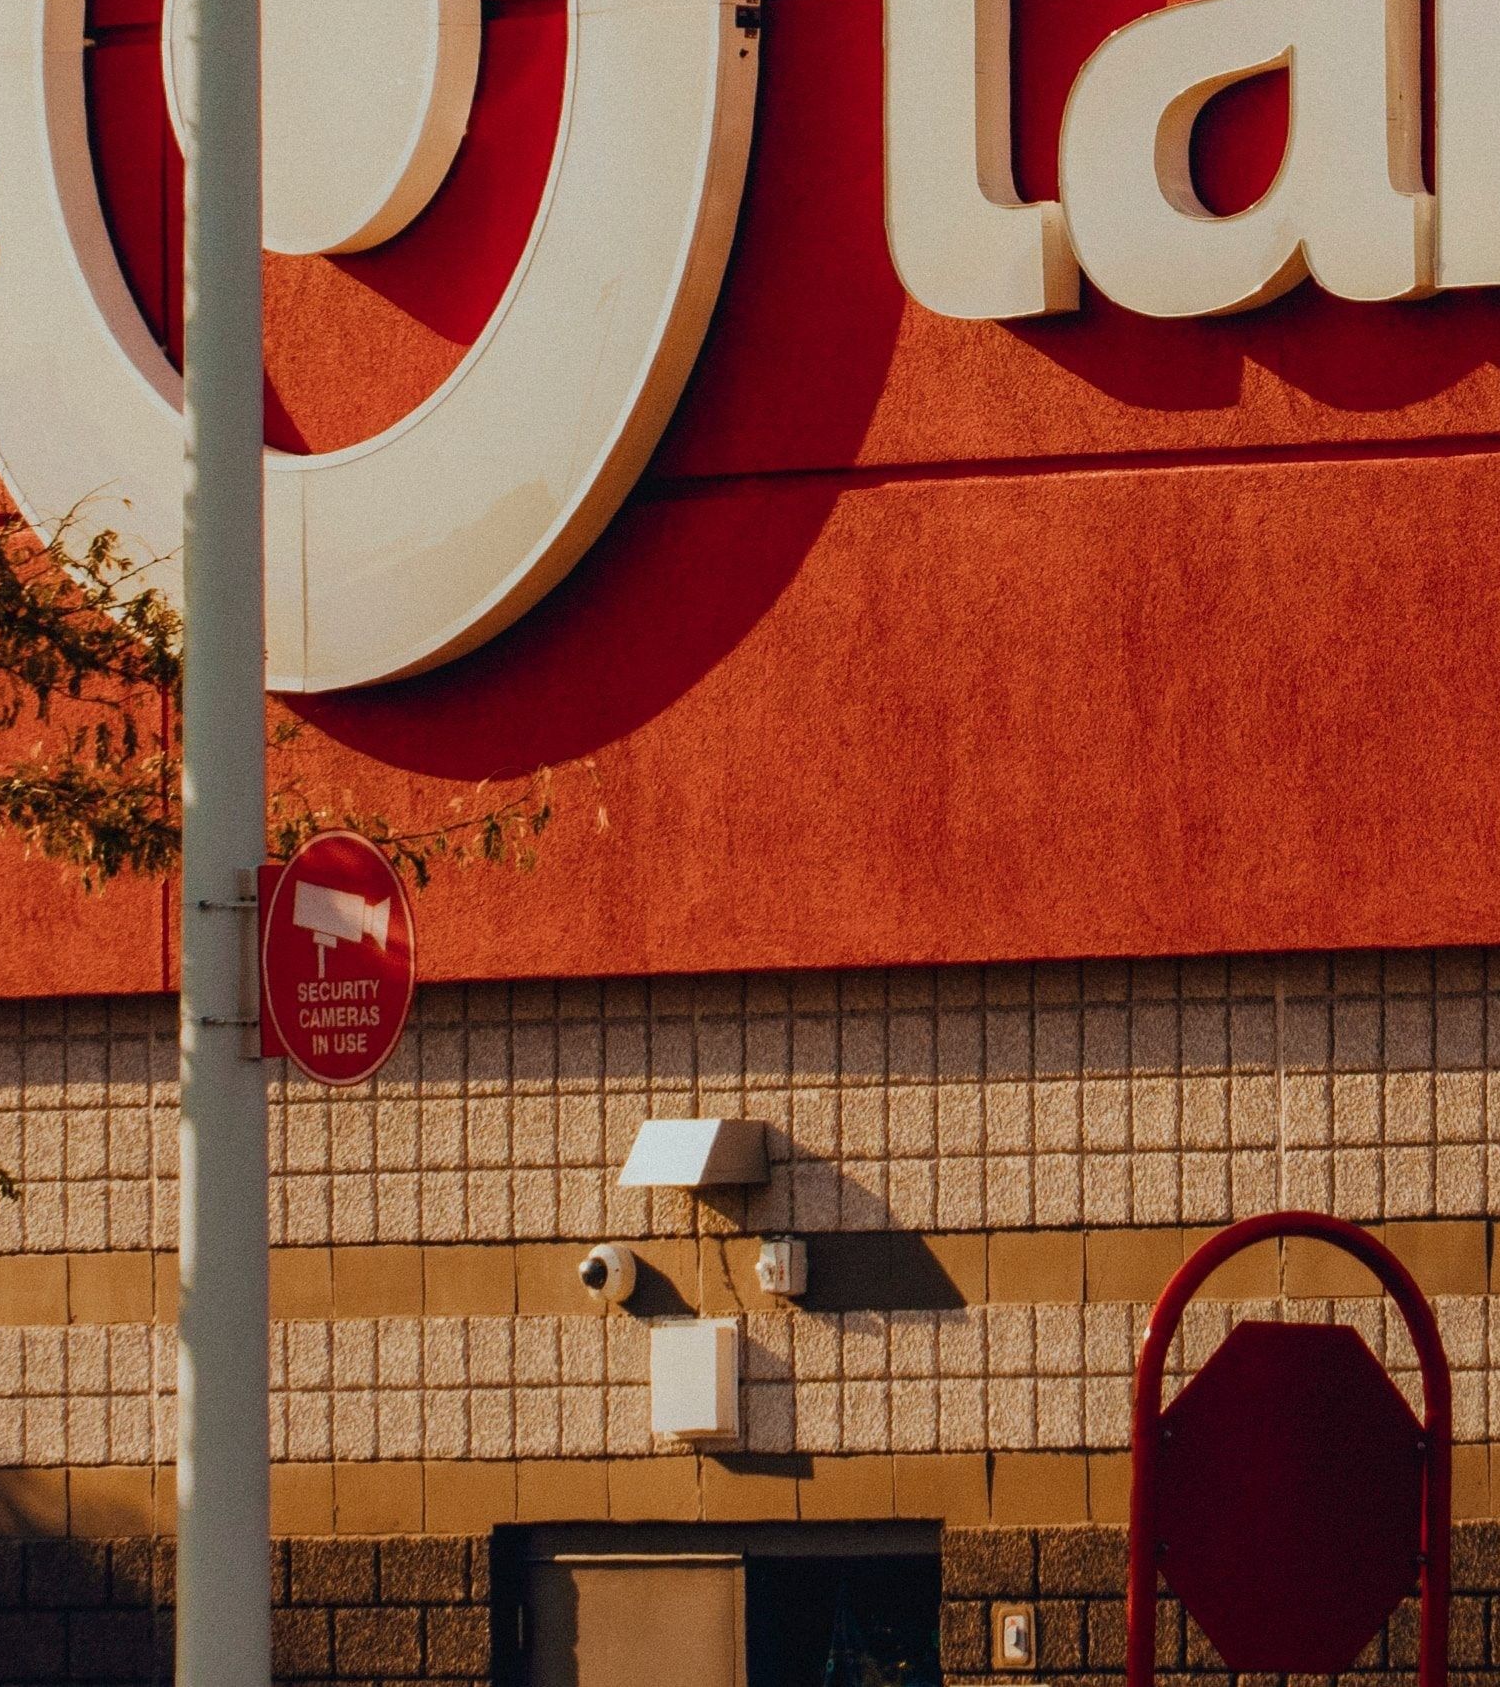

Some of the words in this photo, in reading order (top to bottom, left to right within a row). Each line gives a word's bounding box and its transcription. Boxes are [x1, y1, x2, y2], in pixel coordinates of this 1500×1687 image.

[297, 979, 380, 1002] SECURITY
[300, 1006, 381, 1028] CAMERAS
[312, 1034, 329, 1056] IN
[333, 1032, 368, 1054] USE
